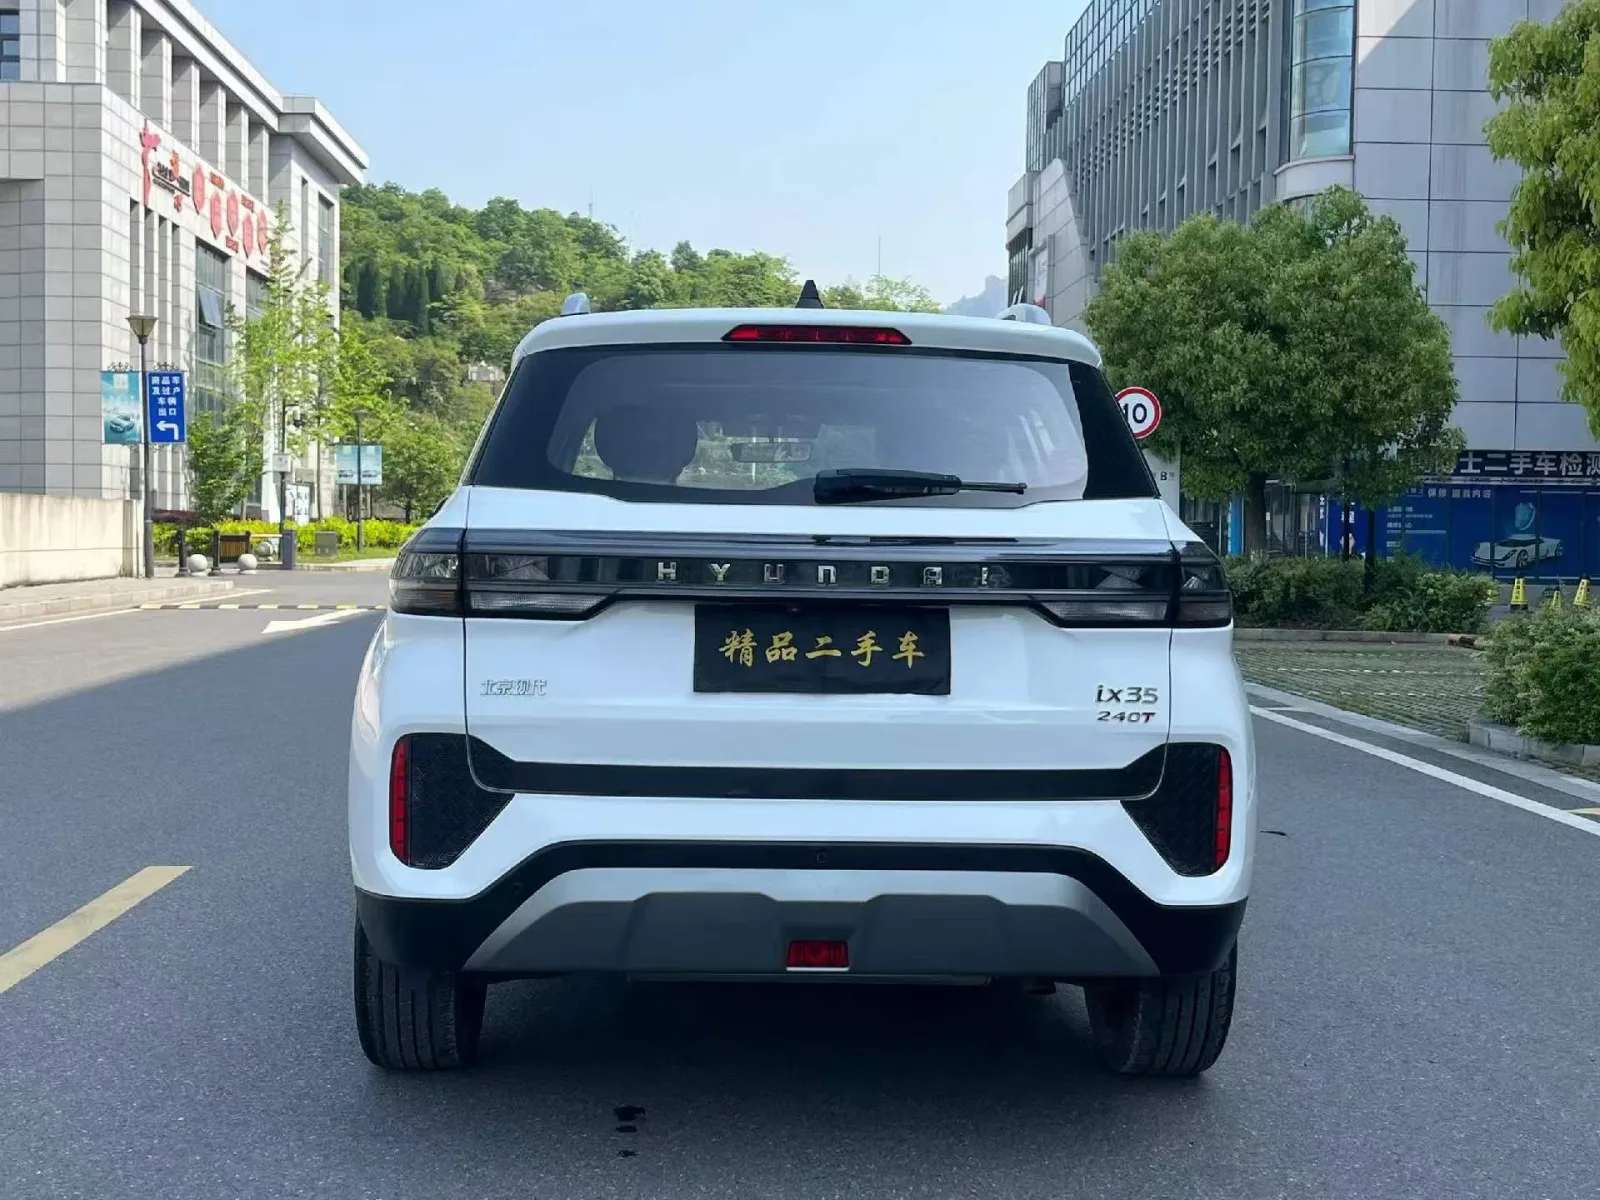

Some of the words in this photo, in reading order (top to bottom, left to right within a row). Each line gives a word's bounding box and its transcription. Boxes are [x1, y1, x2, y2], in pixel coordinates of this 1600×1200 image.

[152, 386, 181, 396] 及过户
[158, 408, 176, 416] 出口
[1122, 403, 1147, 424] 10
[1450, 451, 1600, 476] 士二手车检测
[657, 561, 988, 585] HYUNDAI
[718, 628, 925, 669] 精品二手车
[480, 679, 547, 696] 北京现代
[1096, 684, 1158, 704] ix35
[1097, 710, 1156, 723] 240T
